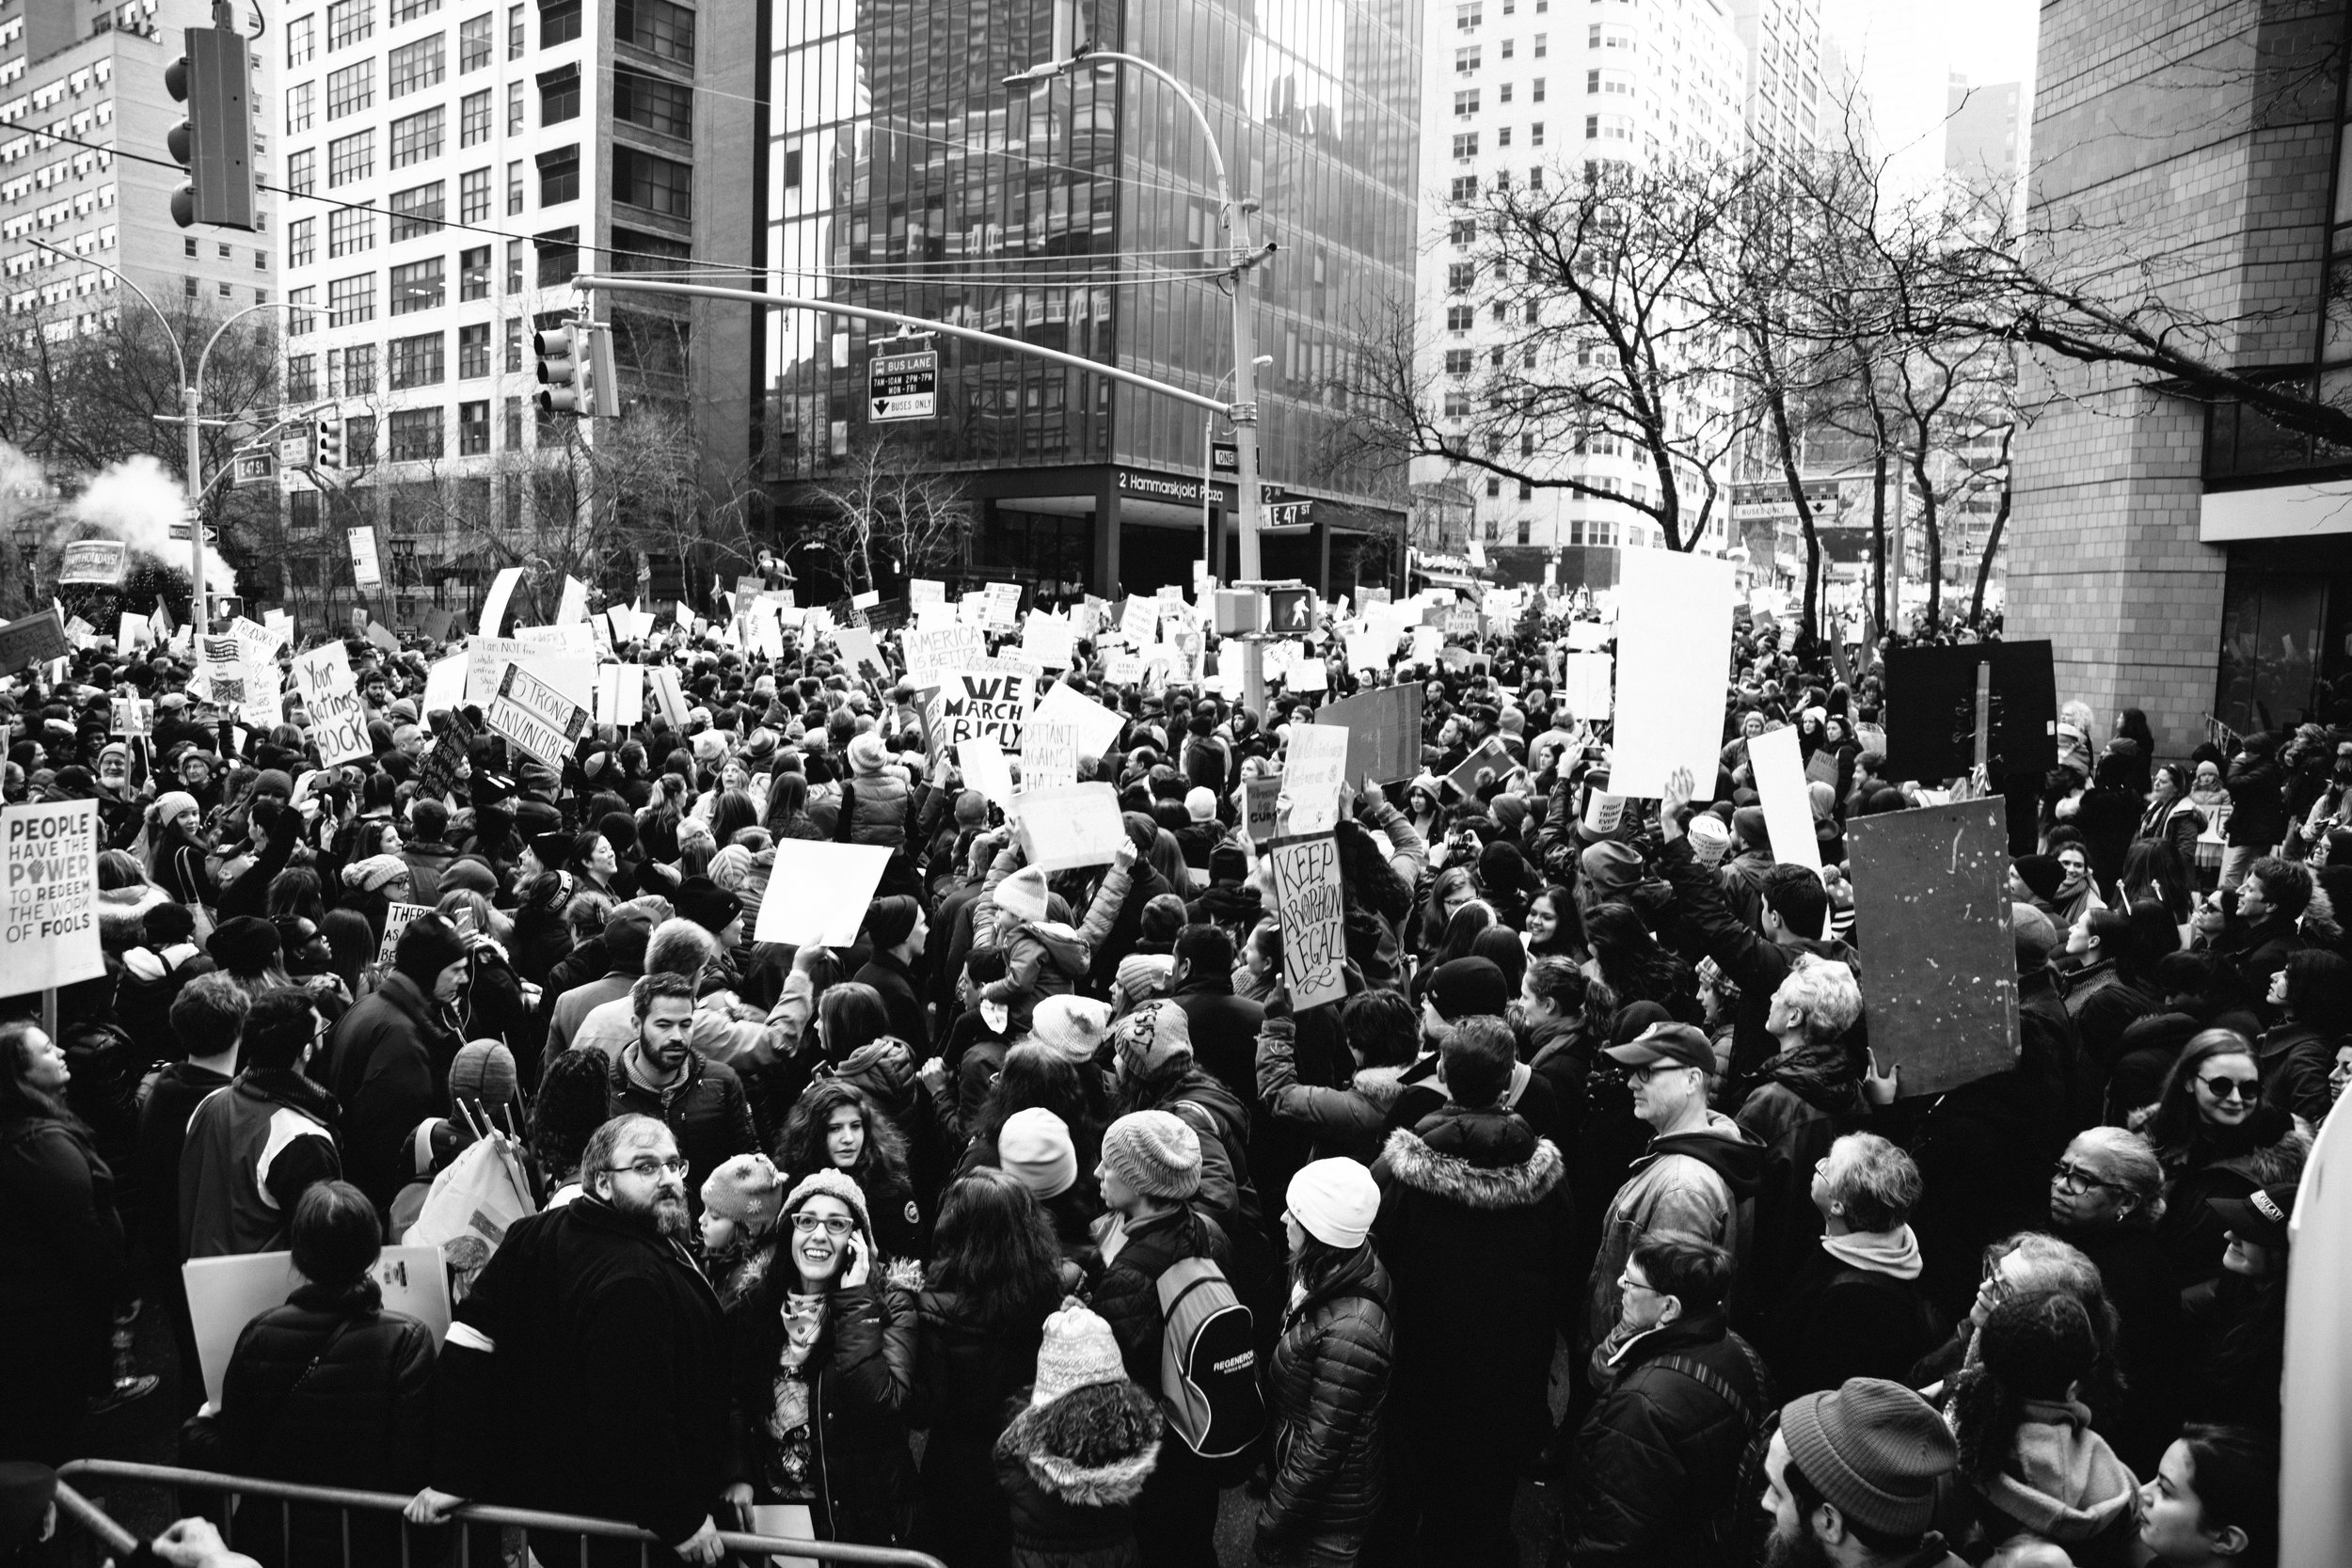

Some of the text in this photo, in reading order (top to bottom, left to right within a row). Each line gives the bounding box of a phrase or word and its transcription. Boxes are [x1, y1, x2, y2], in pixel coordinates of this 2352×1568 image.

[888, 357, 931, 372] BUS LANE
[891, 399, 932, 411] BUSES ONLY
[241, 460, 264, 476] E 47 St
[1219, 451, 1233, 464] ONE
[1120, 472, 1223, 502] 2 Hammarskjold Paza
[1265, 486, 1272, 503] 2
[1273, 504, 1311, 525] E 47 ST
[1767, 506, 1786, 515] ONLY
[1448, 622, 1476, 630] PUSSY
[501, 642, 519, 653] NOT
[523, 644, 535, 655] free
[908, 626, 981, 656] AMERICA
[474, 654, 495, 664] while
[914, 655, 927, 670] IS
[304, 659, 334, 695] Your
[961, 675, 1023, 702] WE
[307, 689, 360, 727] Ratings
[512, 672, 571, 728] STRONG
[944, 696, 1024, 721] MARCH
[318, 716, 372, 765] SUCK
[491, 698, 571, 765] INVINCIBLE
[1024, 748, 1075, 768] AGAINST
[1602, 802, 1621, 811] FIGHT
[10, 813, 89, 842] PEOPLE
[9, 836, 89, 861] HAVE THE
[8, 854, 89, 887] PWER
[1276, 842, 1334, 900] KEEP
[10, 879, 90, 905] TO REDEEM
[9, 896, 90, 924] THE WORK
[392, 906, 433, 922] THER
[1281, 881, 1343, 946] ABORTION
[7, 913, 90, 943] OF FOOLS
[384, 928, 399, 942] AS
[380, 948, 398, 961] BE
[1284, 922, 1344, 988] LEGAL!
[1214, 1349, 1254, 1371] REGENERON
